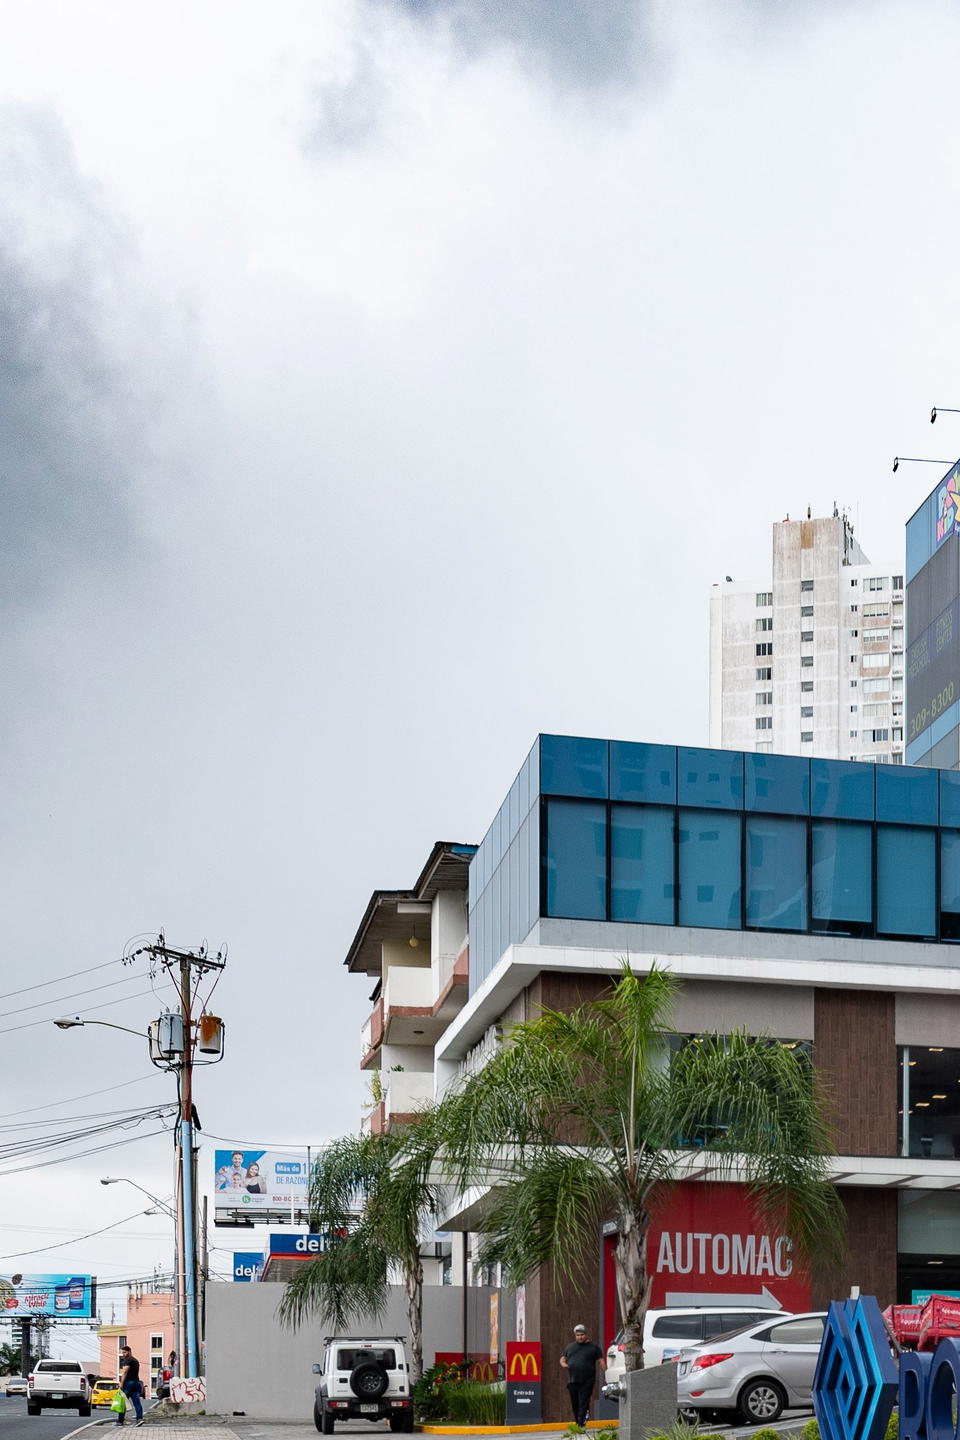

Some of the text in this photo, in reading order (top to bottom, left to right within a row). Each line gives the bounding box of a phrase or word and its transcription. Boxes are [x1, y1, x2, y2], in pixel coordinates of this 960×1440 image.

[910, 681, 954, 737] 309-8300
[276, 1175, 284, 1185] DE
[656, 1231, 793, 1278] AUTOMAC
